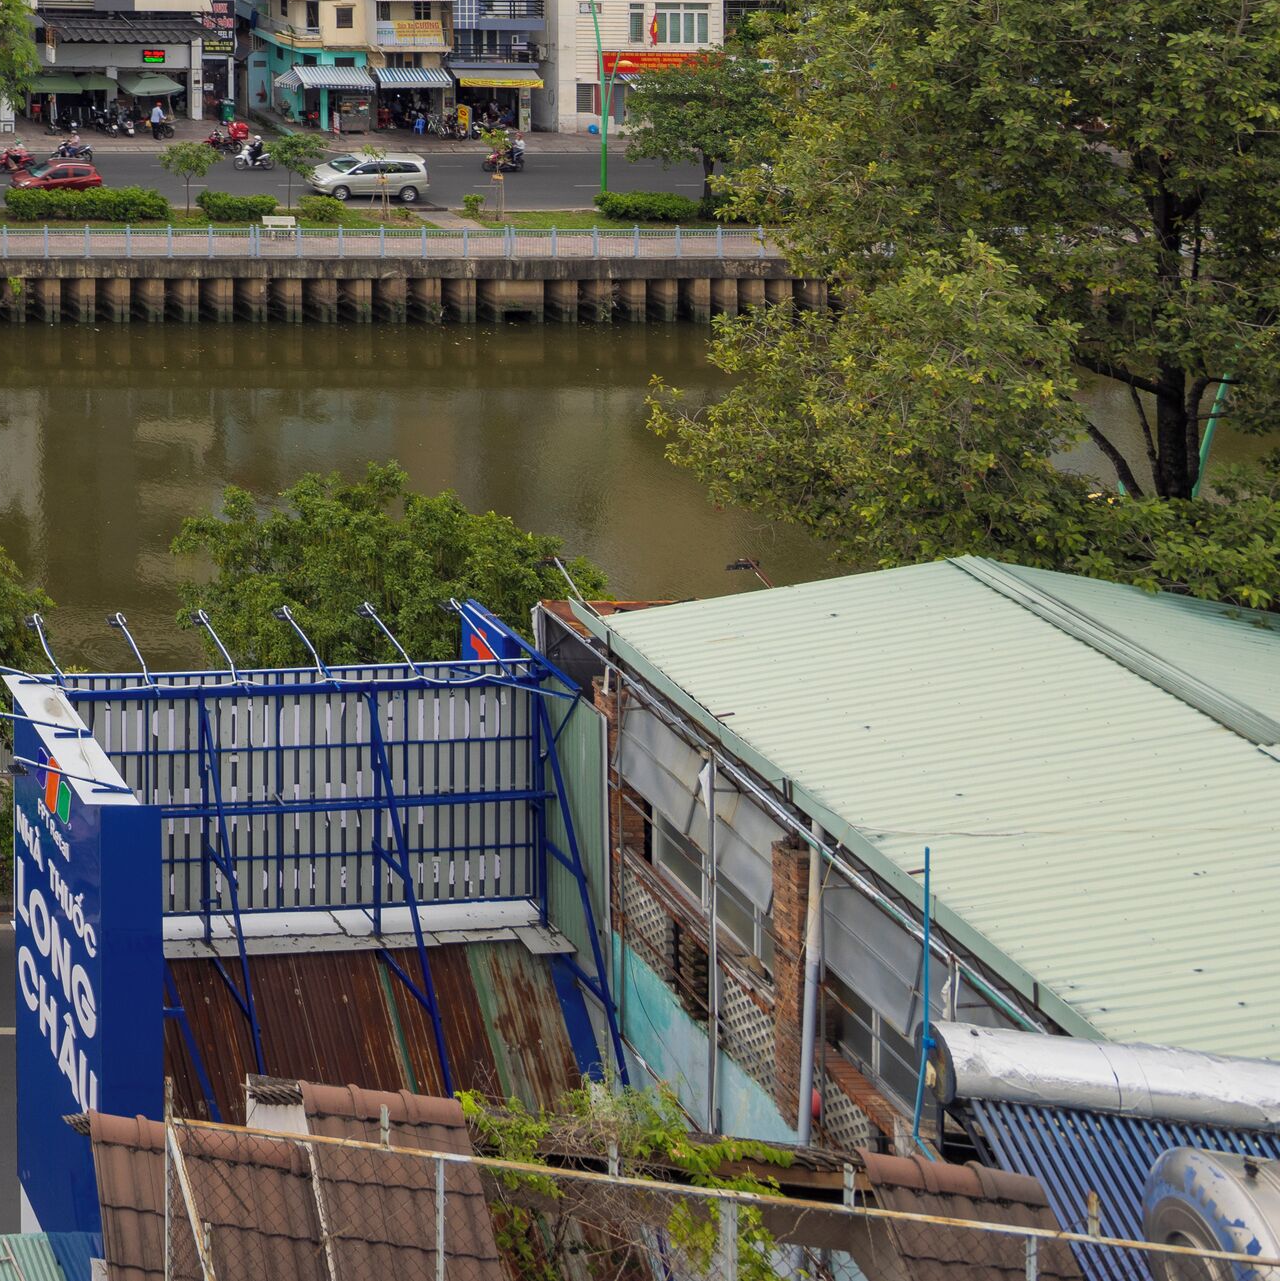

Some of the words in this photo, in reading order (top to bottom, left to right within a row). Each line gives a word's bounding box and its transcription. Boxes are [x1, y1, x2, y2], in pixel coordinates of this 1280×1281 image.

[16, 805, 44, 873] NHÀ
[48, 858, 97, 959] THUỐC
[38, 798, 50, 829] FPT
[50, 819, 70, 863] Retail
[17, 857, 97, 1039] LONG
[18, 946, 98, 1113] CHÂU
